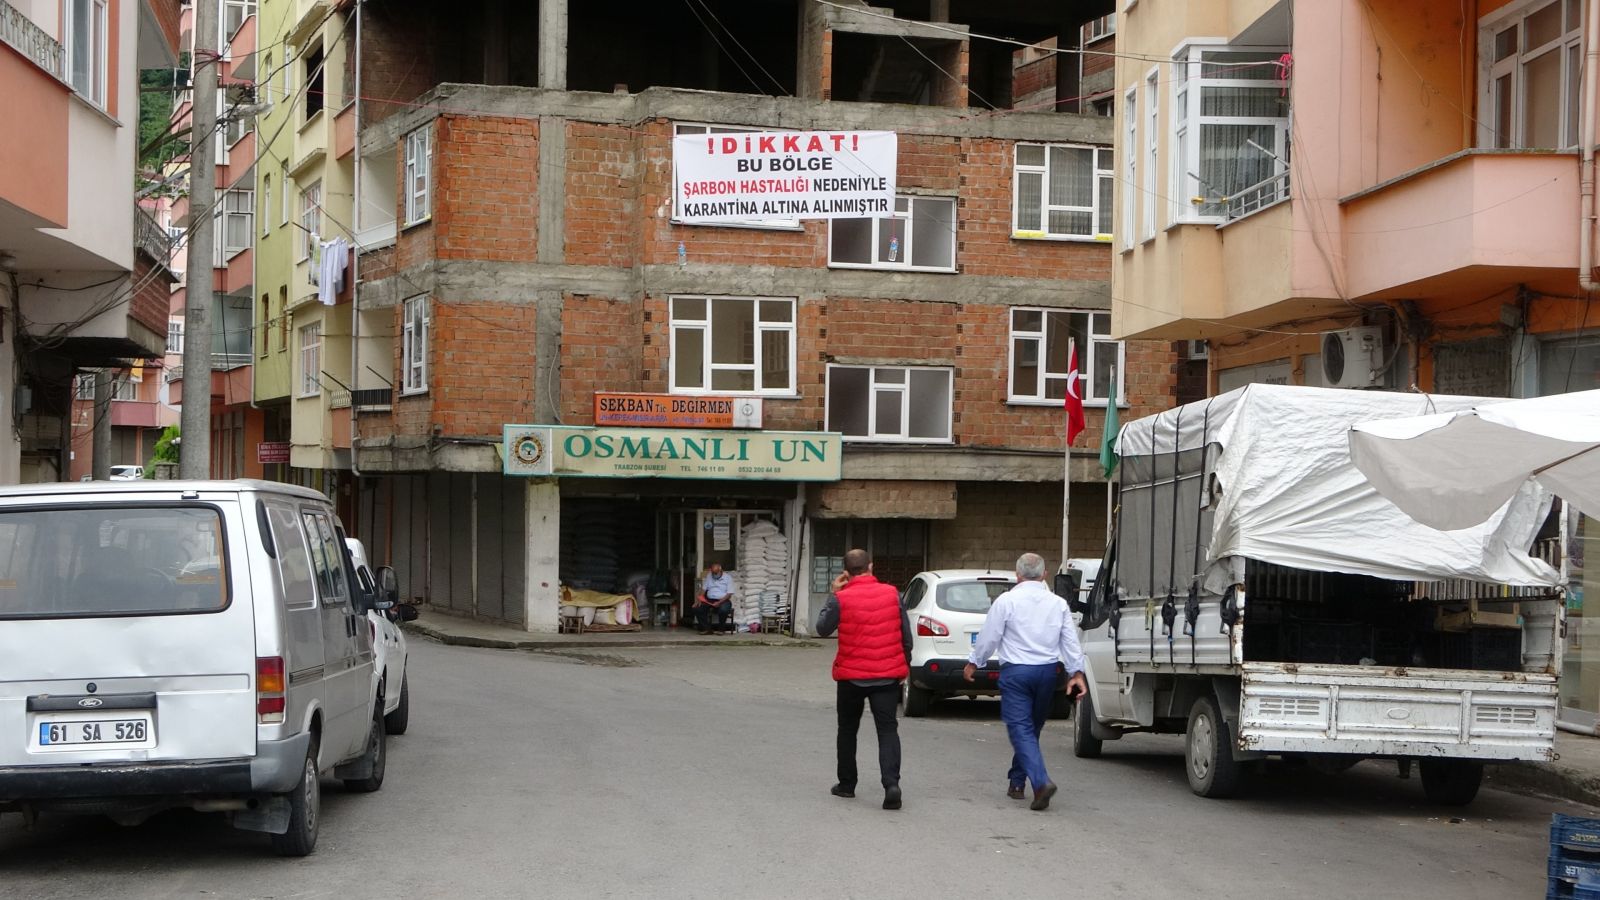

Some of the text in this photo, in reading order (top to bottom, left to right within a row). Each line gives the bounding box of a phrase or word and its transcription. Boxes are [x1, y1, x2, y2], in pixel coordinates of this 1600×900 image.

[737, 154, 833, 173] BU BÖLGE
[683, 174, 887, 199] ŞARBON HASTALIĞI NEDENİYLE
[684, 198, 889, 217] KARANTİNA ALTINA ALINMIŞTIR
[599, 398, 653, 412] SEKBAN
[563, 434, 750, 461] OSMANLI
[771, 439, 828, 462] UN
[614, 463, 643, 471] TRABZON
[49, 724, 67, 742] 61
[82, 723, 102, 741] SA
[115, 722, 144, 740] 526
